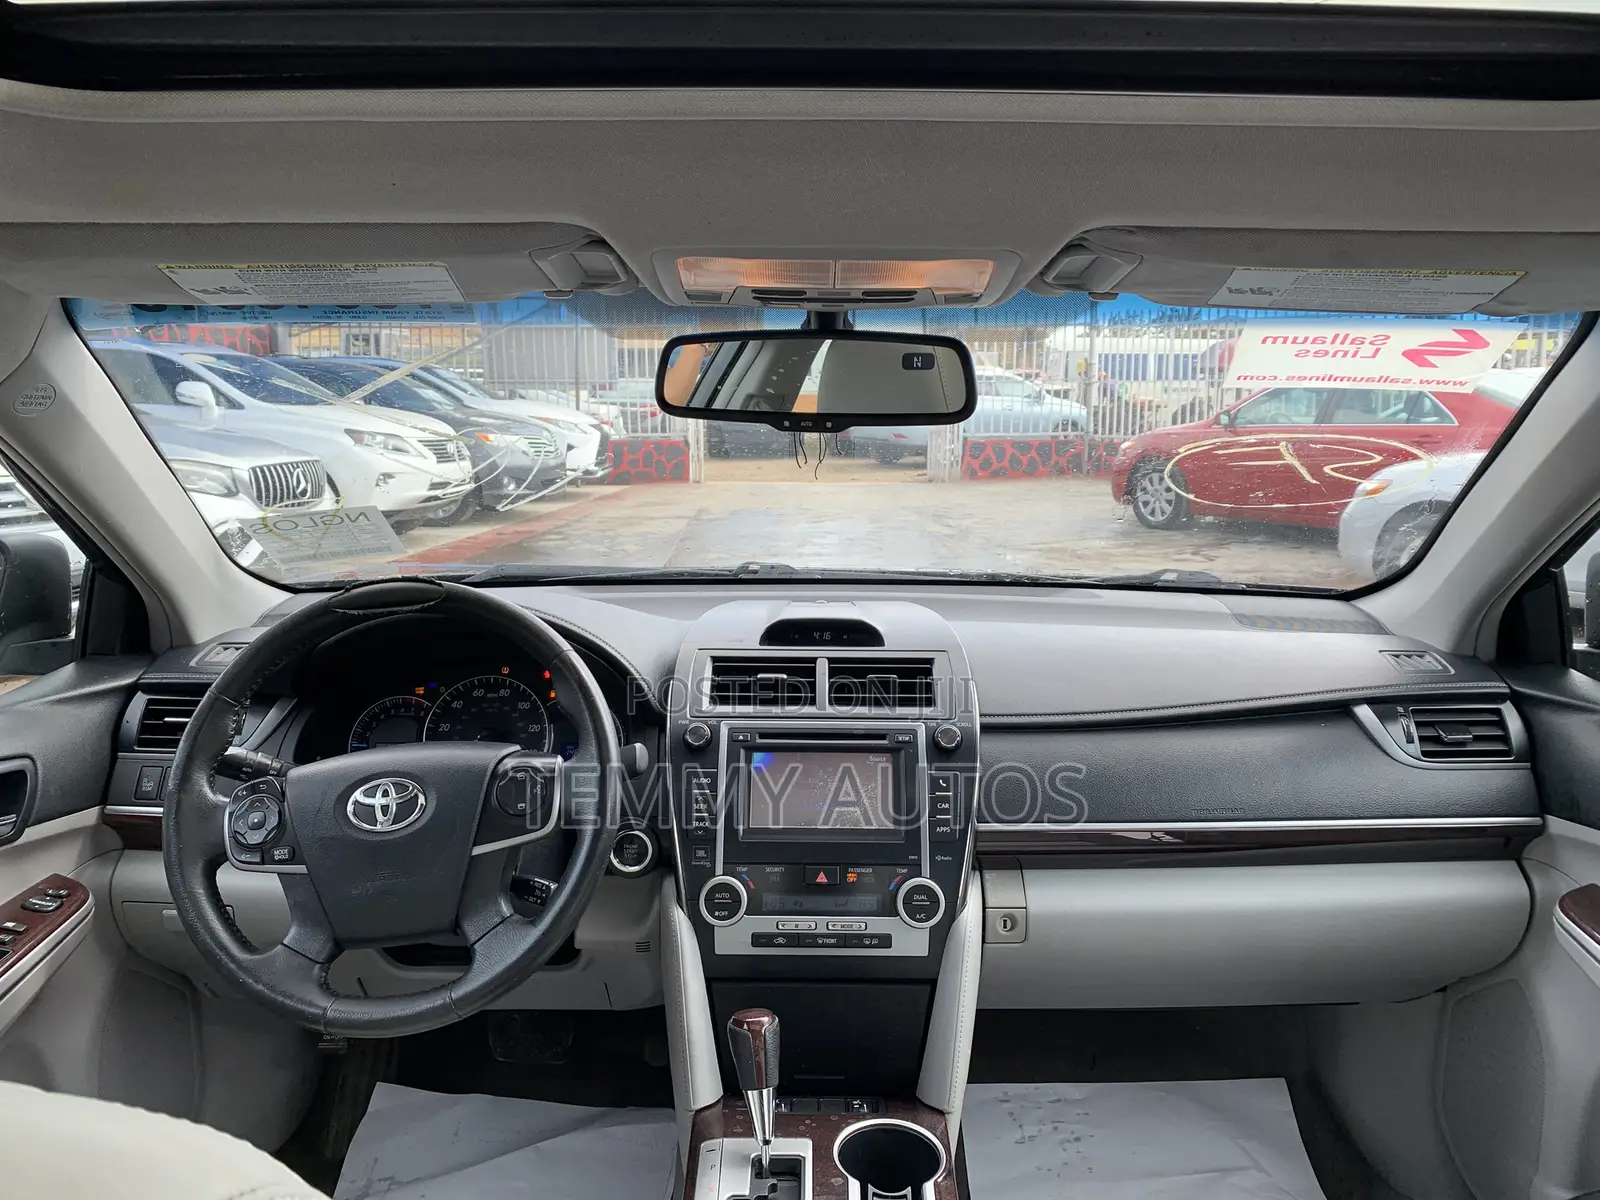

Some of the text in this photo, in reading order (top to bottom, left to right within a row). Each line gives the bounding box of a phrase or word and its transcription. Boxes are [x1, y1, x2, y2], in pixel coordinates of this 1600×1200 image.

[913, 356, 922, 368] N
[472, 688, 485, 697] 60
[499, 688, 511, 697] 80
[451, 700, 463, 709] 40
[517, 701, 531, 709] 100
[438, 723, 450, 731] 20
[528, 724, 541, 732] 120
[692, 820, 710, 828] TRACK
